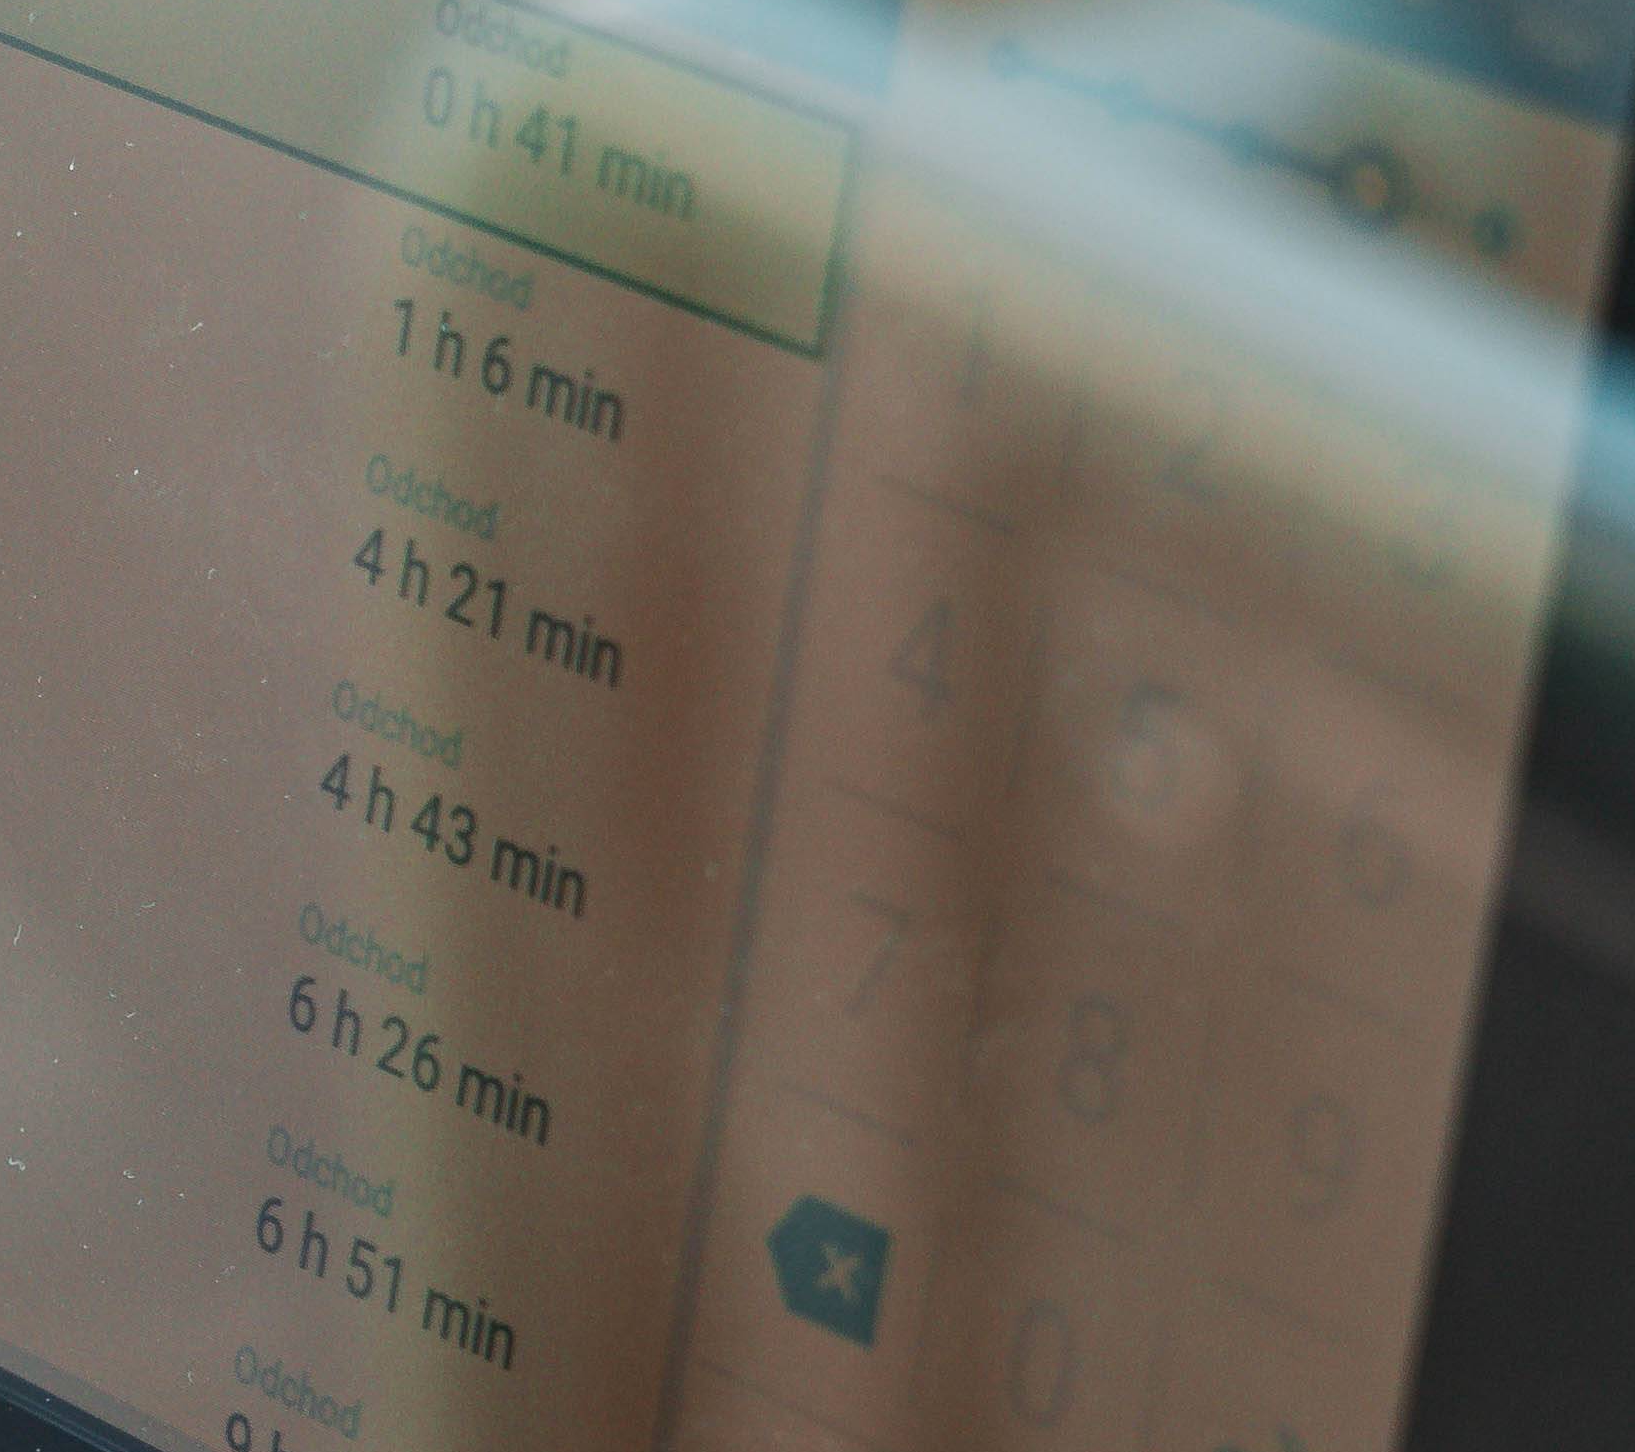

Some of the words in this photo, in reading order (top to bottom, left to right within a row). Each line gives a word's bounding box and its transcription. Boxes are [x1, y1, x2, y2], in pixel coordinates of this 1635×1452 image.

[422, 66, 456, 129] 0
[469, 83, 505, 153] h
[515, 107, 578, 177] 41
[596, 146, 699, 225] min
[402, 224, 532, 310] Odchod
[394, 298, 416, 356] 1
[433, 310, 466, 378] h
[481, 335, 513, 396] 6
[526, 364, 626, 443] min
[367, 454, 501, 542] Odchod
[353, 528, 384, 585] 4
[399, 539, 431, 607] h
[445, 562, 508, 638] 21
[526, 609, 623, 689] min
[892, 597, 954, 725] 4
[332, 681, 463, 767] Odchod
[320, 754, 351, 810] 4
[364, 766, 396, 833] h
[411, 794, 478, 868] 43
[490, 838, 587, 918] min
[1334, 775, 1409, 909] 6
[298, 901, 428, 994] Odchod
[846, 894, 913, 1020] 7
[288, 975, 317, 1034] 6
[330, 989, 362, 1056] h
[376, 1015, 442, 1093] 26
[456, 1064, 551, 1146] min
[1058, 993, 1135, 1126] 8
[266, 1124, 393, 1218] Odchod
[1288, 1091, 1362, 1229] 9
[255, 1196, 284, 1255] 6
[298, 1210, 329, 1278] h
[345, 1237, 403, 1313] 51
[423, 1289, 516, 1371] min
[235, 1346, 362, 1439] Odchod
[1005, 1299, 1077, 1430] 0
